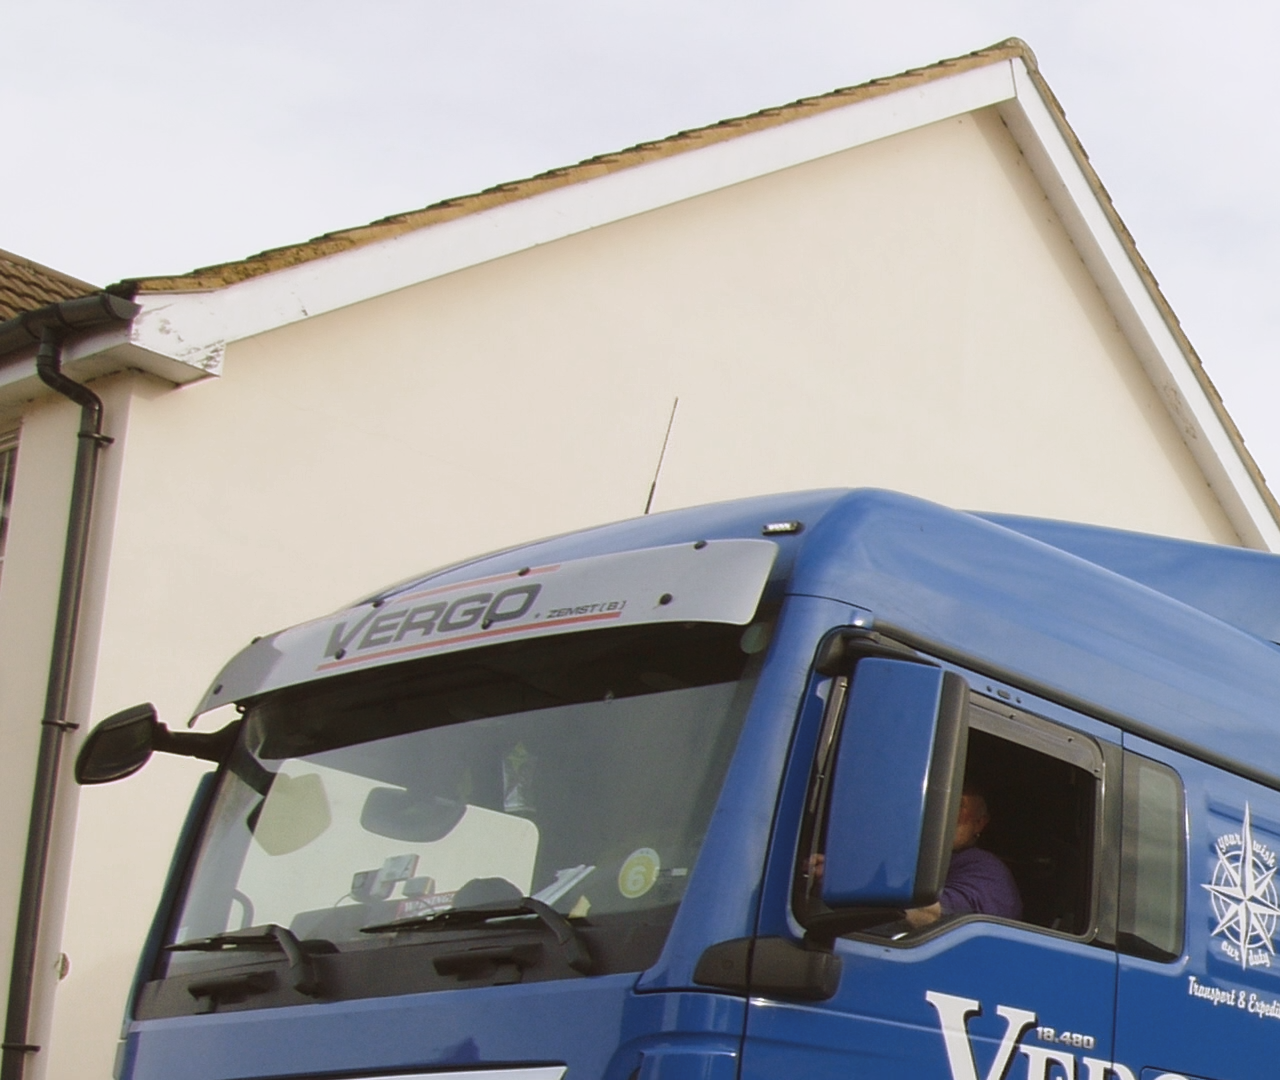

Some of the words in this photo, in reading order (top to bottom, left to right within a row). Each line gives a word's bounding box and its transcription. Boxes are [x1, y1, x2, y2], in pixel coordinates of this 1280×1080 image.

[324, 583, 542, 658] VERGO
[1253, 840, 1276, 867] wish
[1188, 975, 1236, 1007] Transport
[1237, 991, 1246, 1009] &
[1036, 1025, 1095, 1049] 18.480
